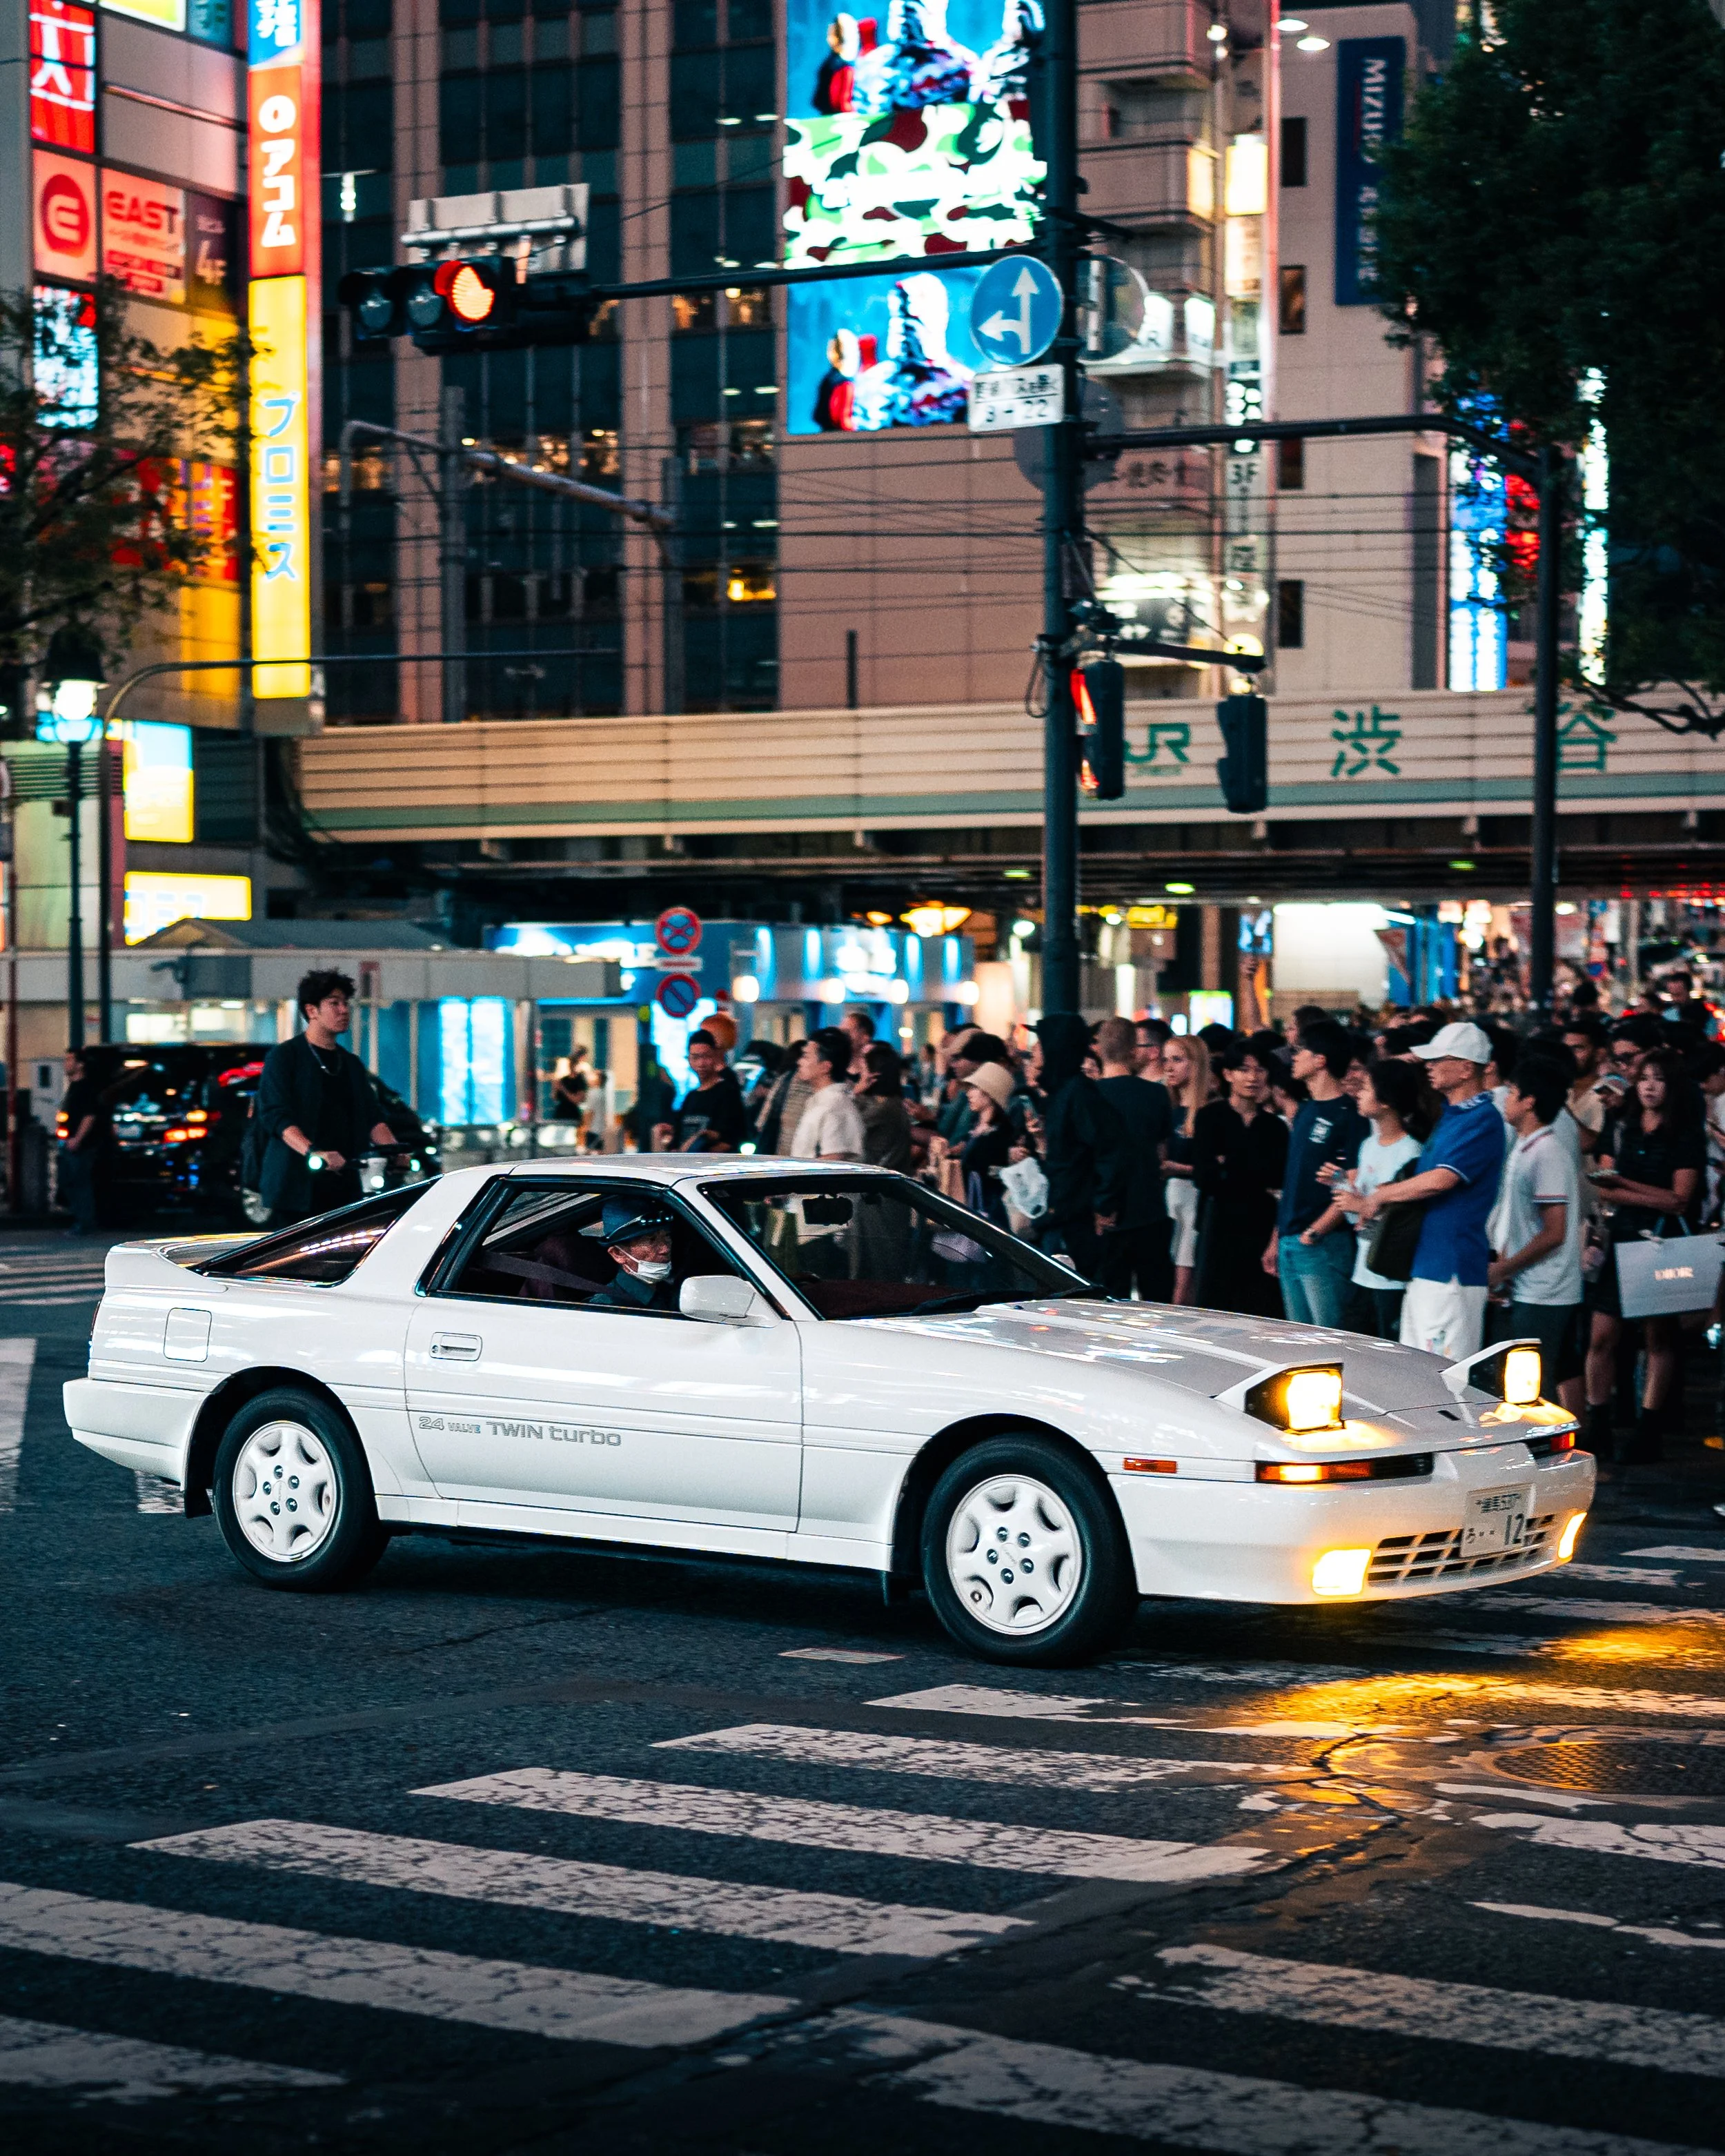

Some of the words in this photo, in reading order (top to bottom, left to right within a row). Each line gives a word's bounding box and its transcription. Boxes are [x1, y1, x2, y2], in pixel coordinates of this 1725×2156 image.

[106, 190, 179, 235] EAST
[259, 139, 297, 248] アコム
[263, 391, 302, 582] プロミス
[1123, 722, 1192, 764] JR
[419, 1416, 444, 1431] 24
[448, 1421, 481, 1434] VALVE
[486, 1421, 543, 1440] TWIN
[549, 1425, 622, 1447] turbo
